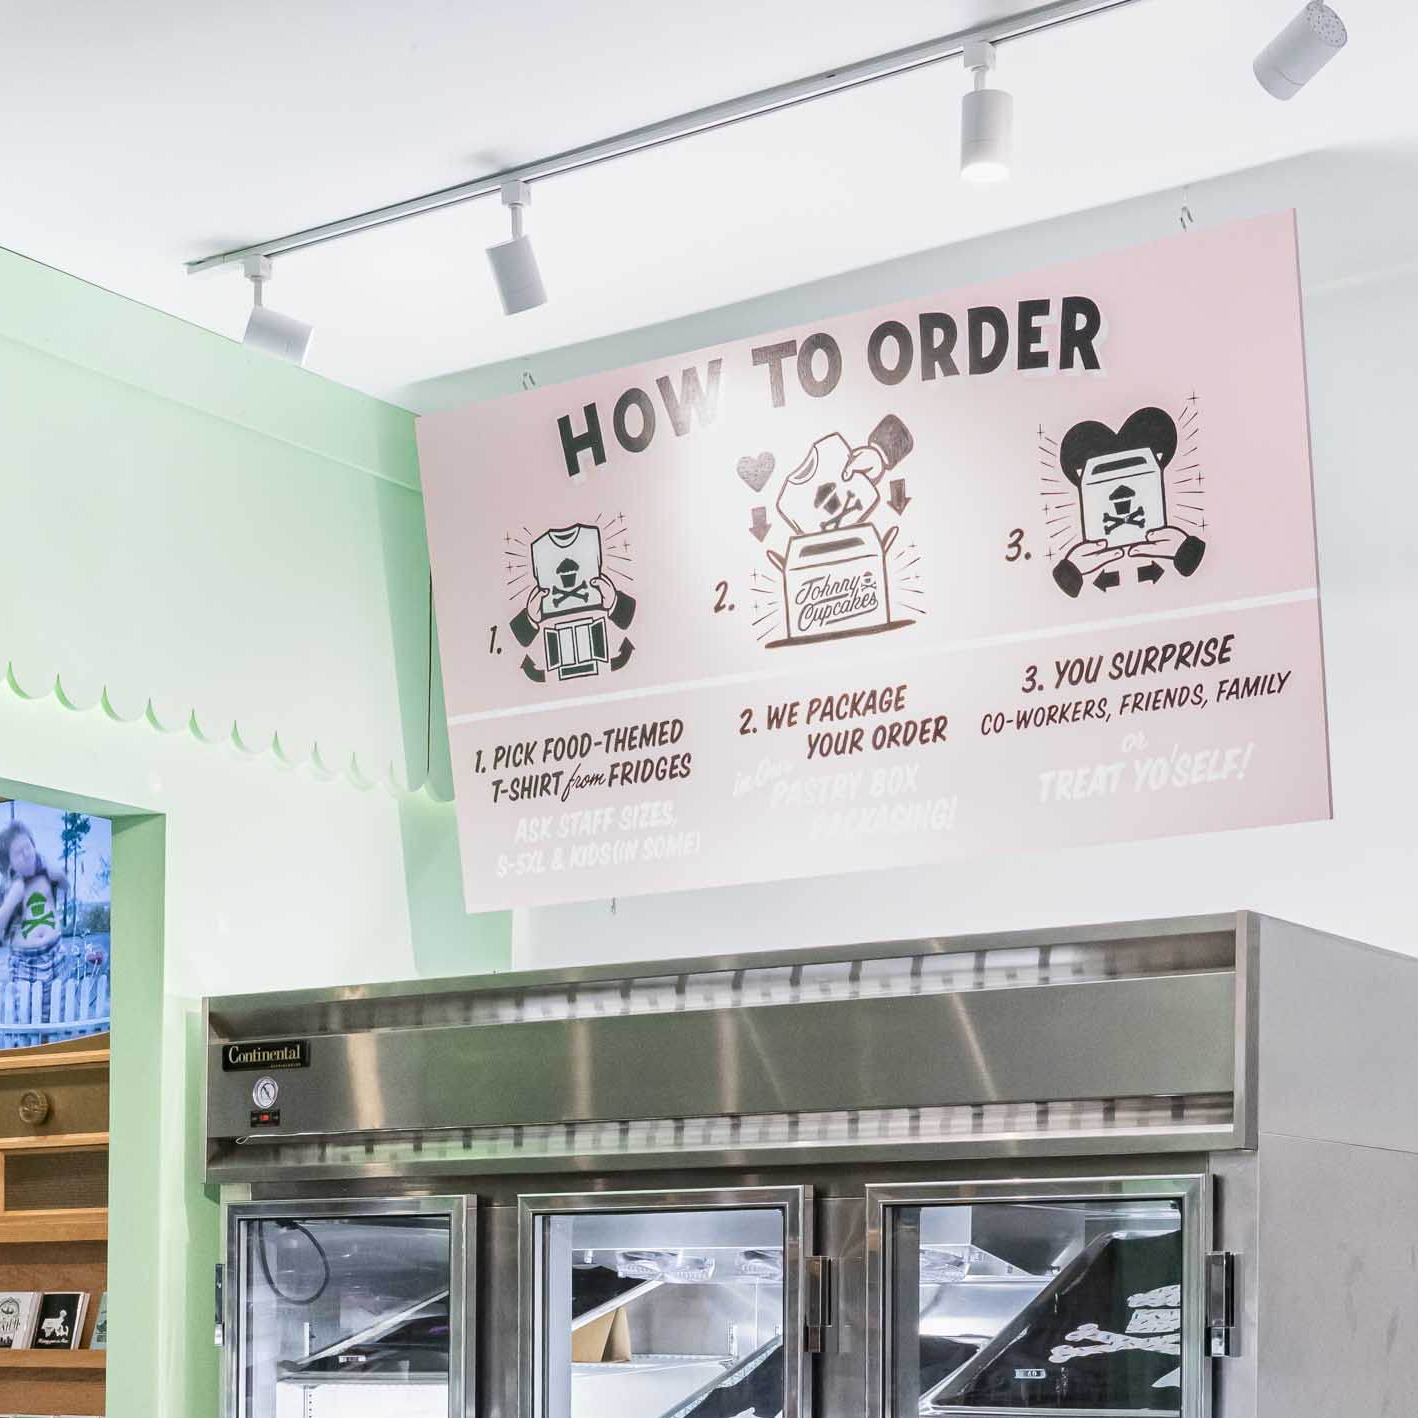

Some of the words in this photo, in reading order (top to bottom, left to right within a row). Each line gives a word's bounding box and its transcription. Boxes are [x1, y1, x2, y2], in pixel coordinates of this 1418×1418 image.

[557, 357, 723, 477] HOW
[751, 332, 843, 408] TO
[867, 296, 1101, 386] ORDER
[1005, 528, 1031, 561] 3.
[713, 580, 735, 613] 2.
[795, 574, 860, 606] Johnny
[798, 592, 878, 632] Cupcakes
[488, 626, 503, 655] 1.
[1021, 665, 1044, 694] 3.
[1054, 655, 1104, 689] YOU
[1108, 633, 1235, 681] SURPRISE
[739, 708, 758, 736] 2.
[767, 701, 800, 731] WE
[805, 684, 907, 725] PACKAGE
[980, 697, 1112, 737] CO-WORKERS,
[1119, 683, 1209, 716] FRIENDS,
[1216, 670, 1292, 703] FAMILY
[475, 750, 486, 773] 1.
[493, 740, 537, 770] PICK
[542, 718, 684, 764] FOOD-THEMED
[807, 727, 864, 760] YOUR
[872, 715, 949, 751] ORDER
[492, 771, 564, 803] T-SHIRT
[561, 762, 605, 802] from
[608, 751, 692, 787] FRIDGES
[869, 761, 923, 798] BOX
[1038, 762, 1126, 803] TREAT
[514, 816, 552, 845] ASK
[557, 806, 616, 839] STAFF
[497, 850, 545, 879] S-5XL
[551, 848, 565, 871] &
[229, 1045, 300, 1064] Continental
